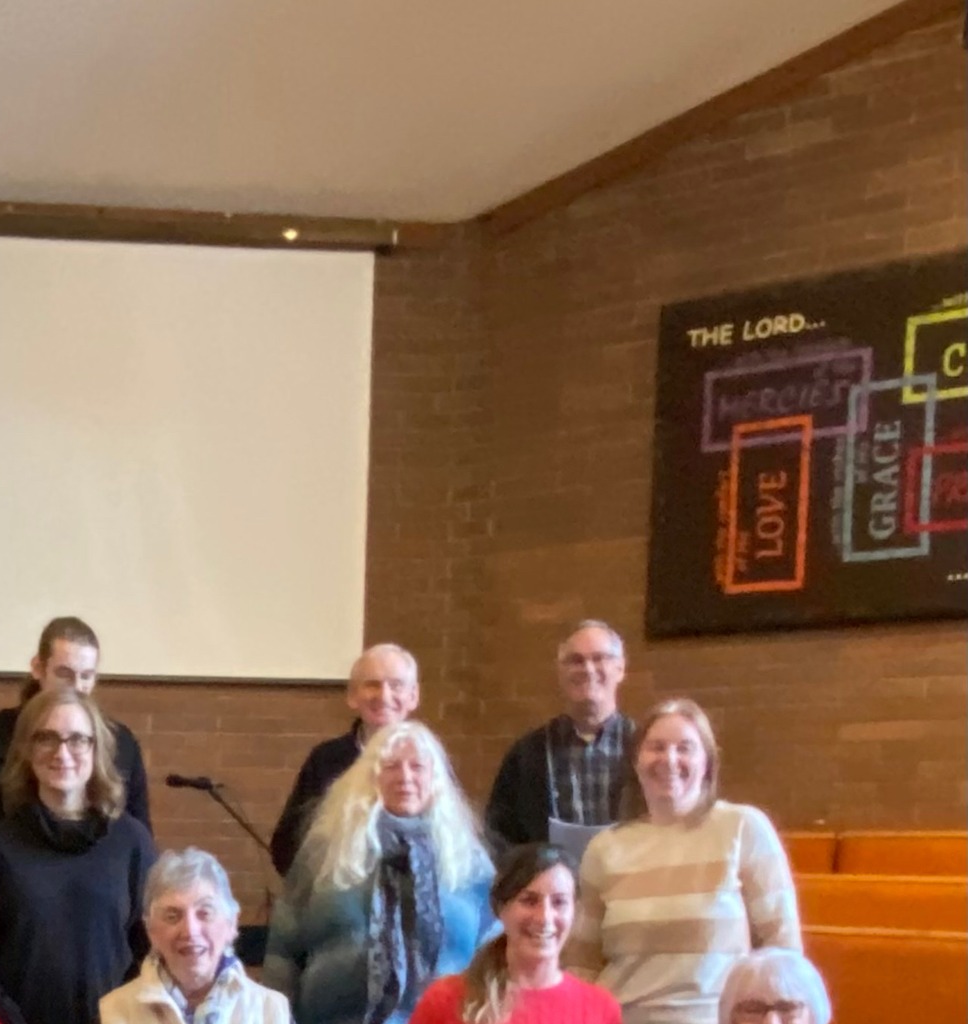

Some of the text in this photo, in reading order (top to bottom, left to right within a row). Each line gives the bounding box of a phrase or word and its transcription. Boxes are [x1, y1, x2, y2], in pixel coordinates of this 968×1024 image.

[687, 312, 827, 348] THE LORD...
[756, 470, 788, 559] LOVE
[868, 420, 902, 540] GRACE
